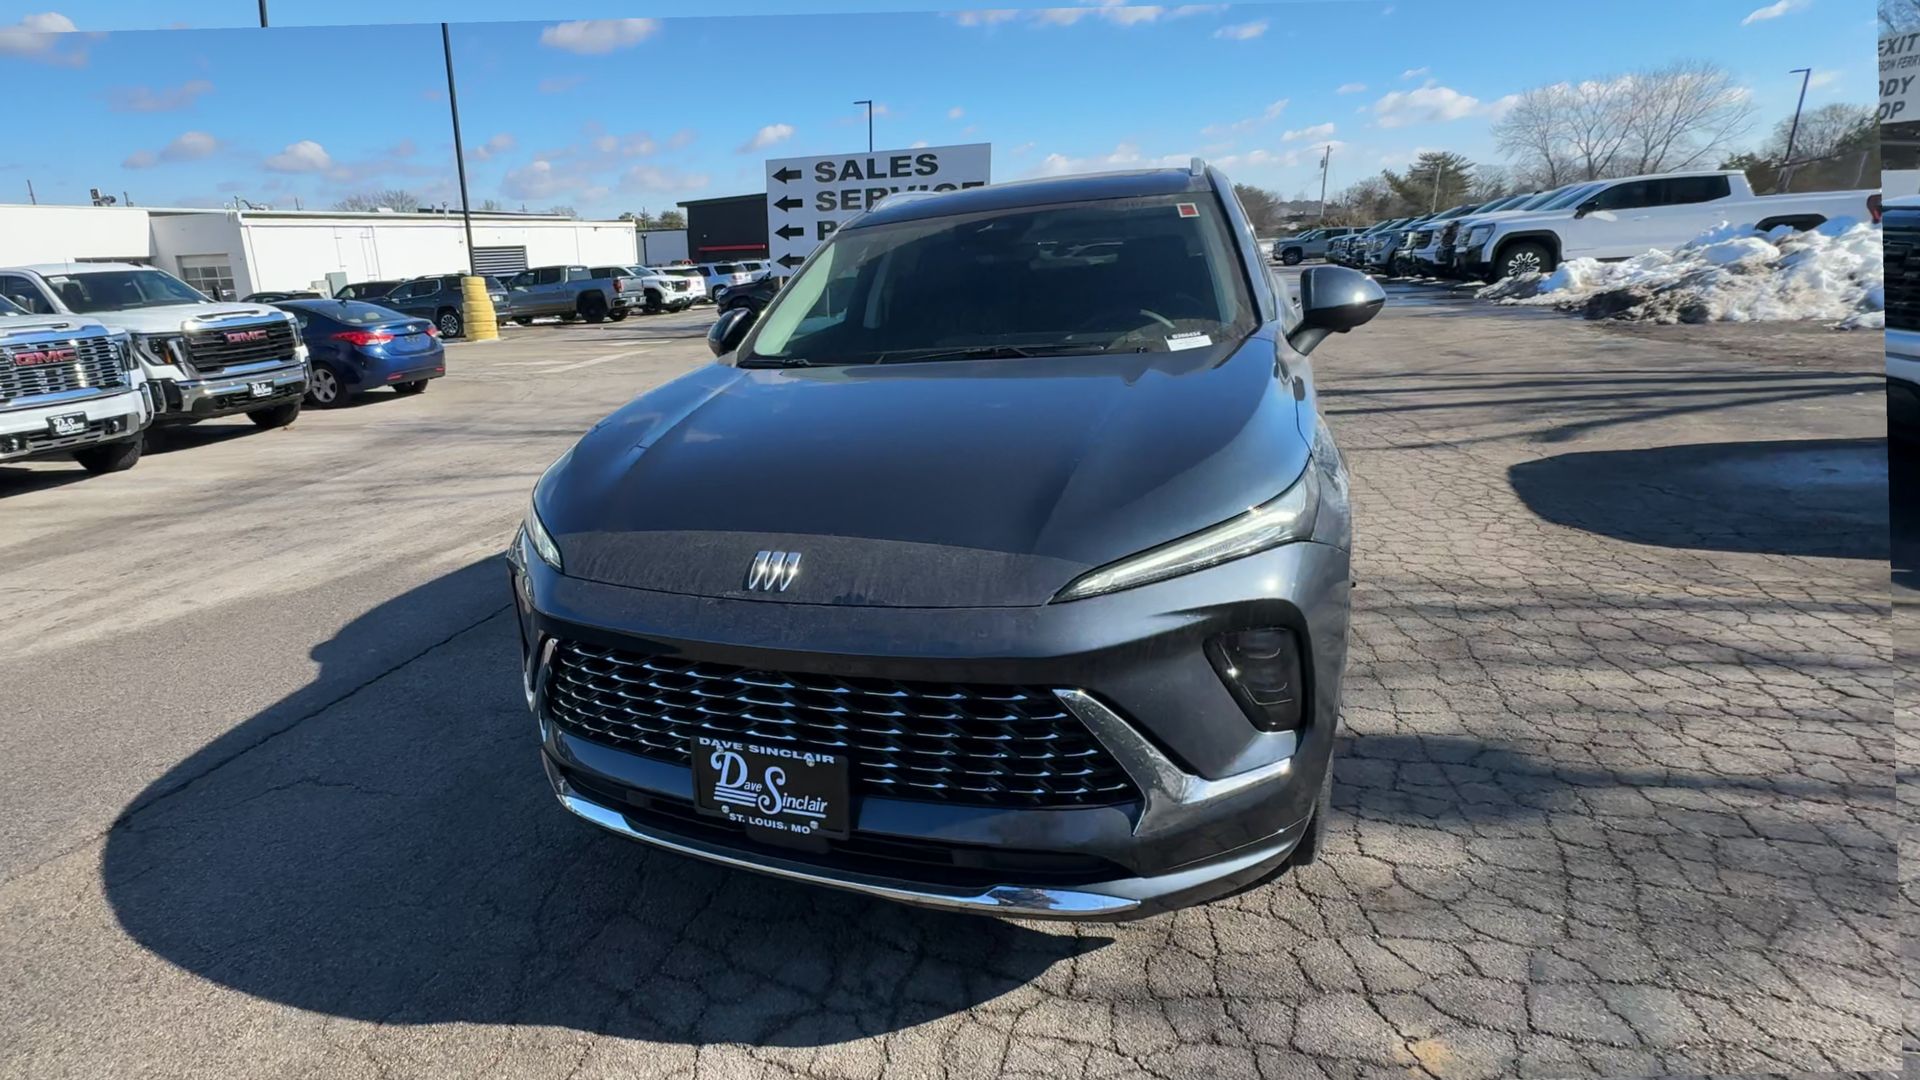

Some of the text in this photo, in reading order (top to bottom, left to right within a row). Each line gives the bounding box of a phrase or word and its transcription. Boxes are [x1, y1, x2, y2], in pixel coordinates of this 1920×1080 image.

[814, 153, 939, 183] SALES
[225, 329, 267, 343] GMC
[15, 348, 77, 366] GMC
[698, 736, 835, 764] DAVE SINCLAIR
[710, 751, 828, 815] Dave Sinclair
[729, 812, 745, 823] ST.
[791, 824, 811, 834] MO
